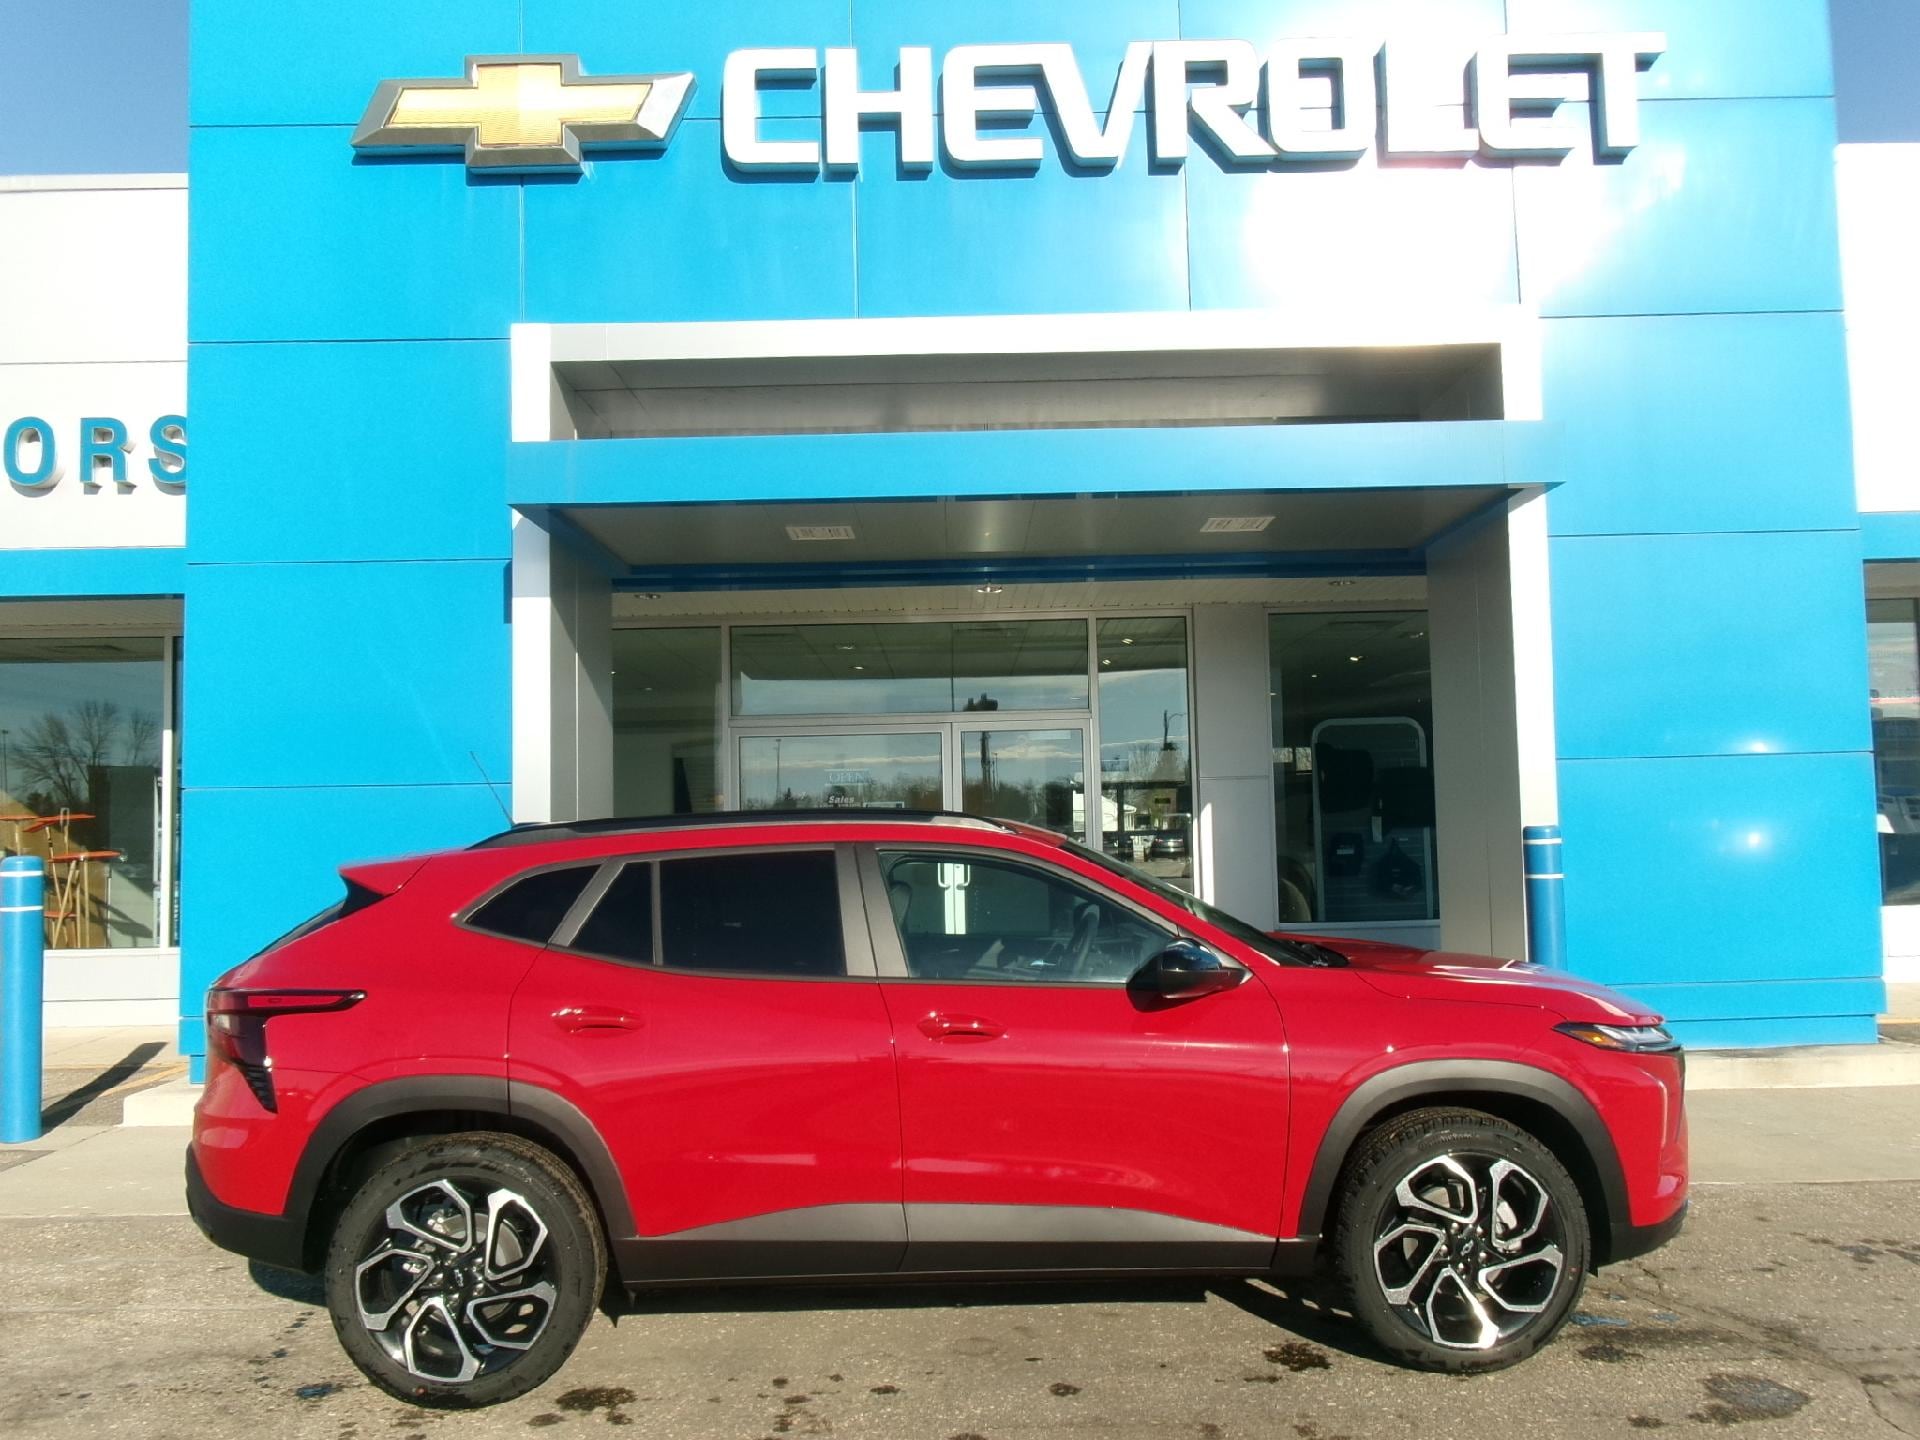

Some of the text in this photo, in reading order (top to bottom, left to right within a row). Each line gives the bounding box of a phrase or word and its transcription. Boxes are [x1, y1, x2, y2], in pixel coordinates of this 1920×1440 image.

[721, 31, 1667, 170] CHEVROLET
[4, 414, 187, 487] ORS
[828, 795, 855, 804] Sales
